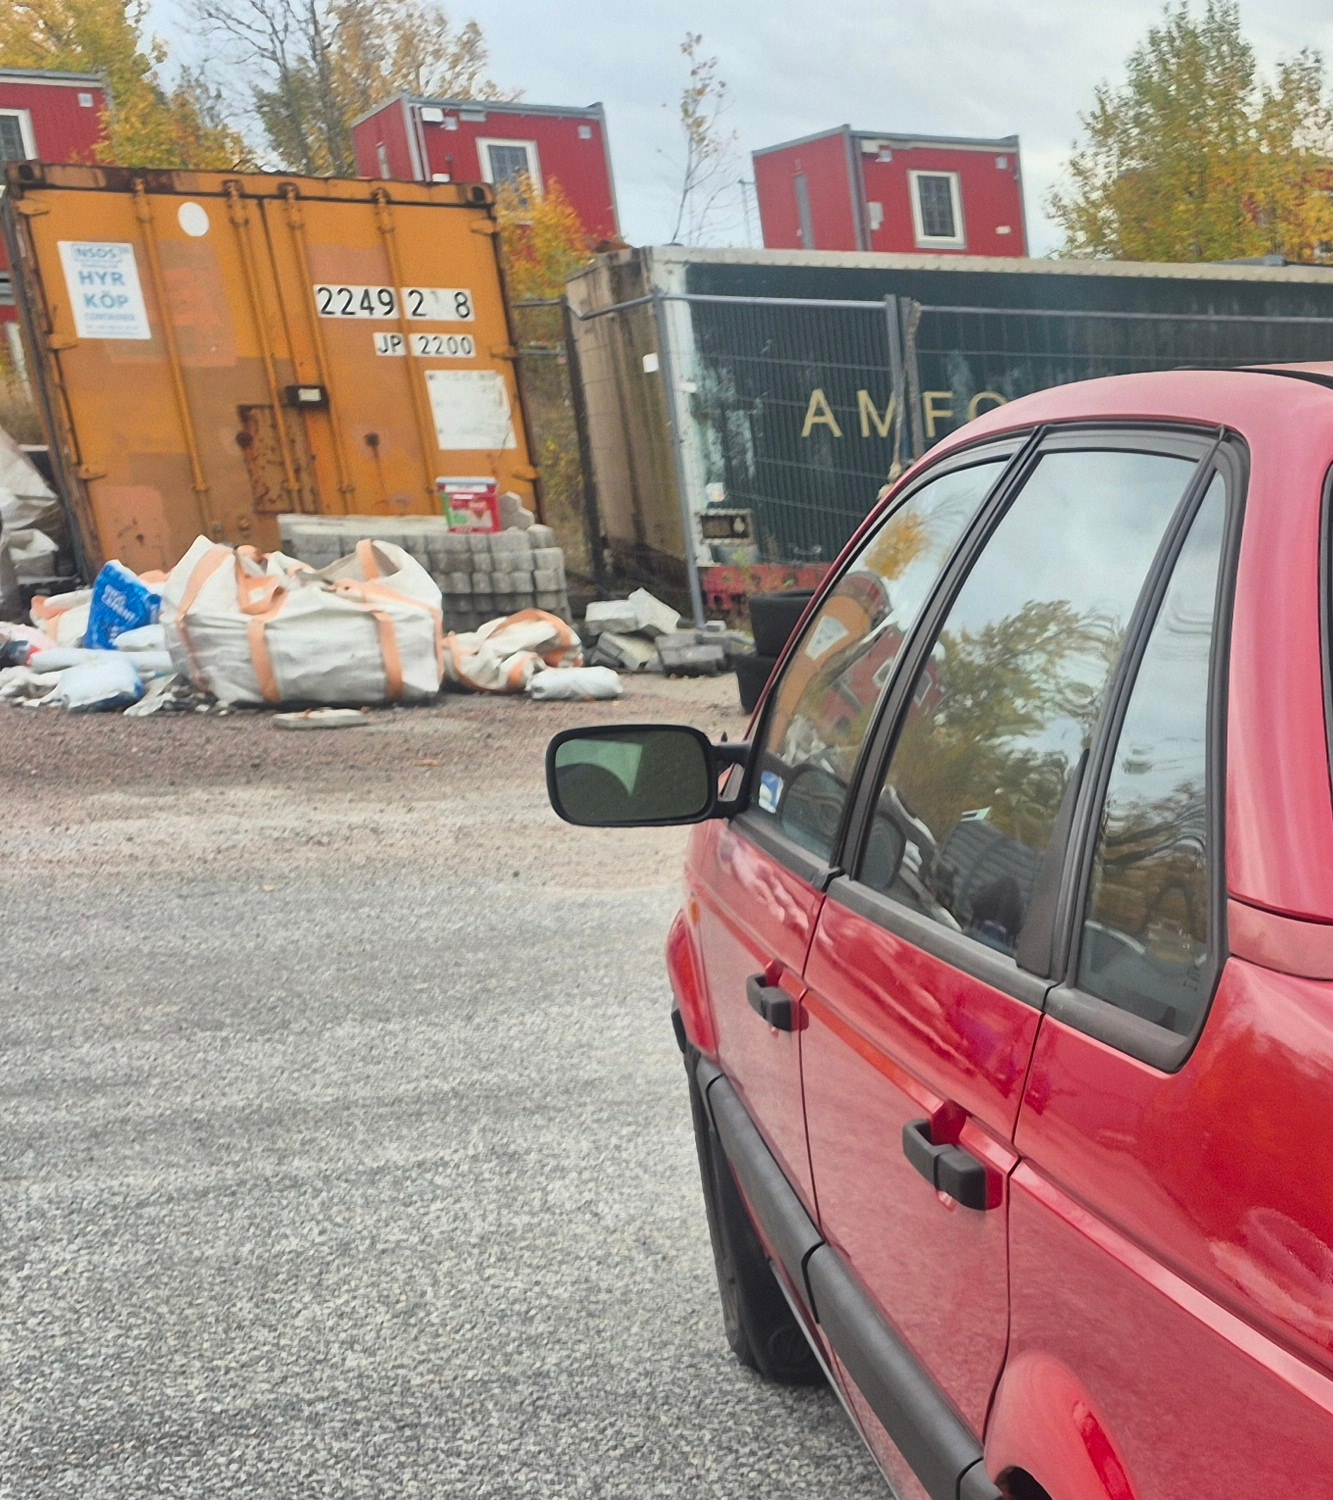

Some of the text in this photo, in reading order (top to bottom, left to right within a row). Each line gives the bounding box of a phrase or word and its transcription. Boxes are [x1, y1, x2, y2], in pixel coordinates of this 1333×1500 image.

[79, 271, 126, 286] HYR
[84, 290, 129, 309] KÖP
[317, 286, 395, 316] 2249
[377, 334, 474, 356] JP 2200
